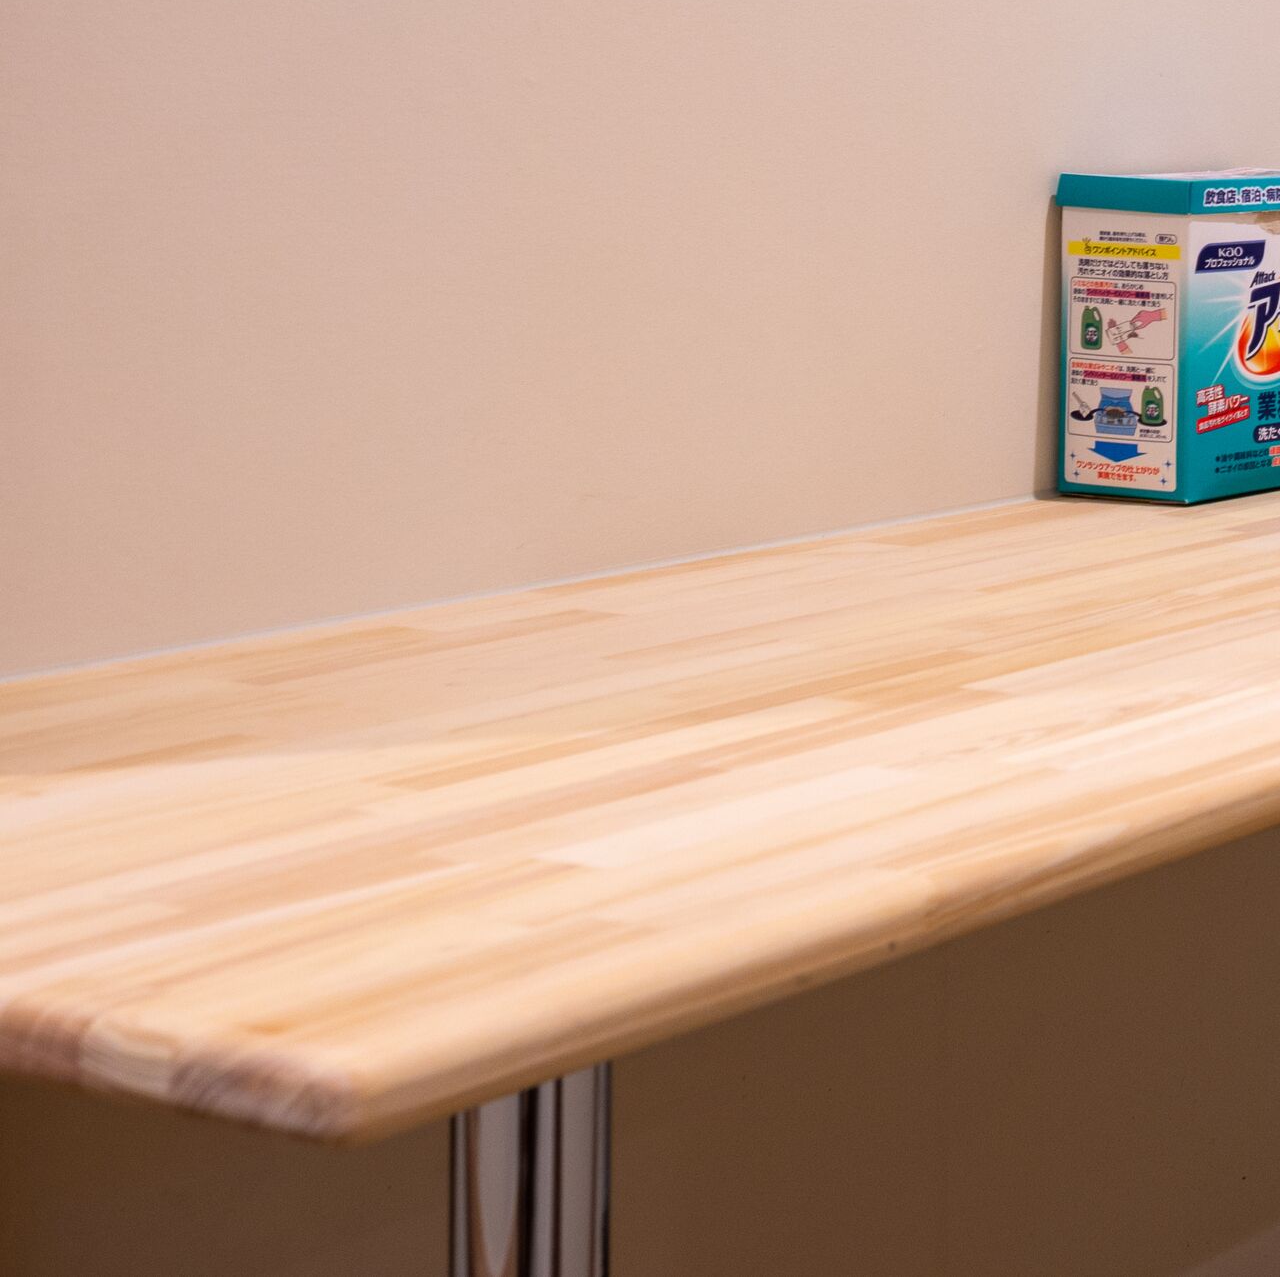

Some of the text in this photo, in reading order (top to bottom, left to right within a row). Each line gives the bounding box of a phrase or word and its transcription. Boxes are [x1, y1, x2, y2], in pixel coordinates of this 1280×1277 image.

[1093, 246, 1156, 256] ワンポイントアドバイス
[1204, 257, 1255, 269] プロフェッショナル
[1250, 271, 1276, 288] Attack
[1197, 385, 1224, 405] 高活性
